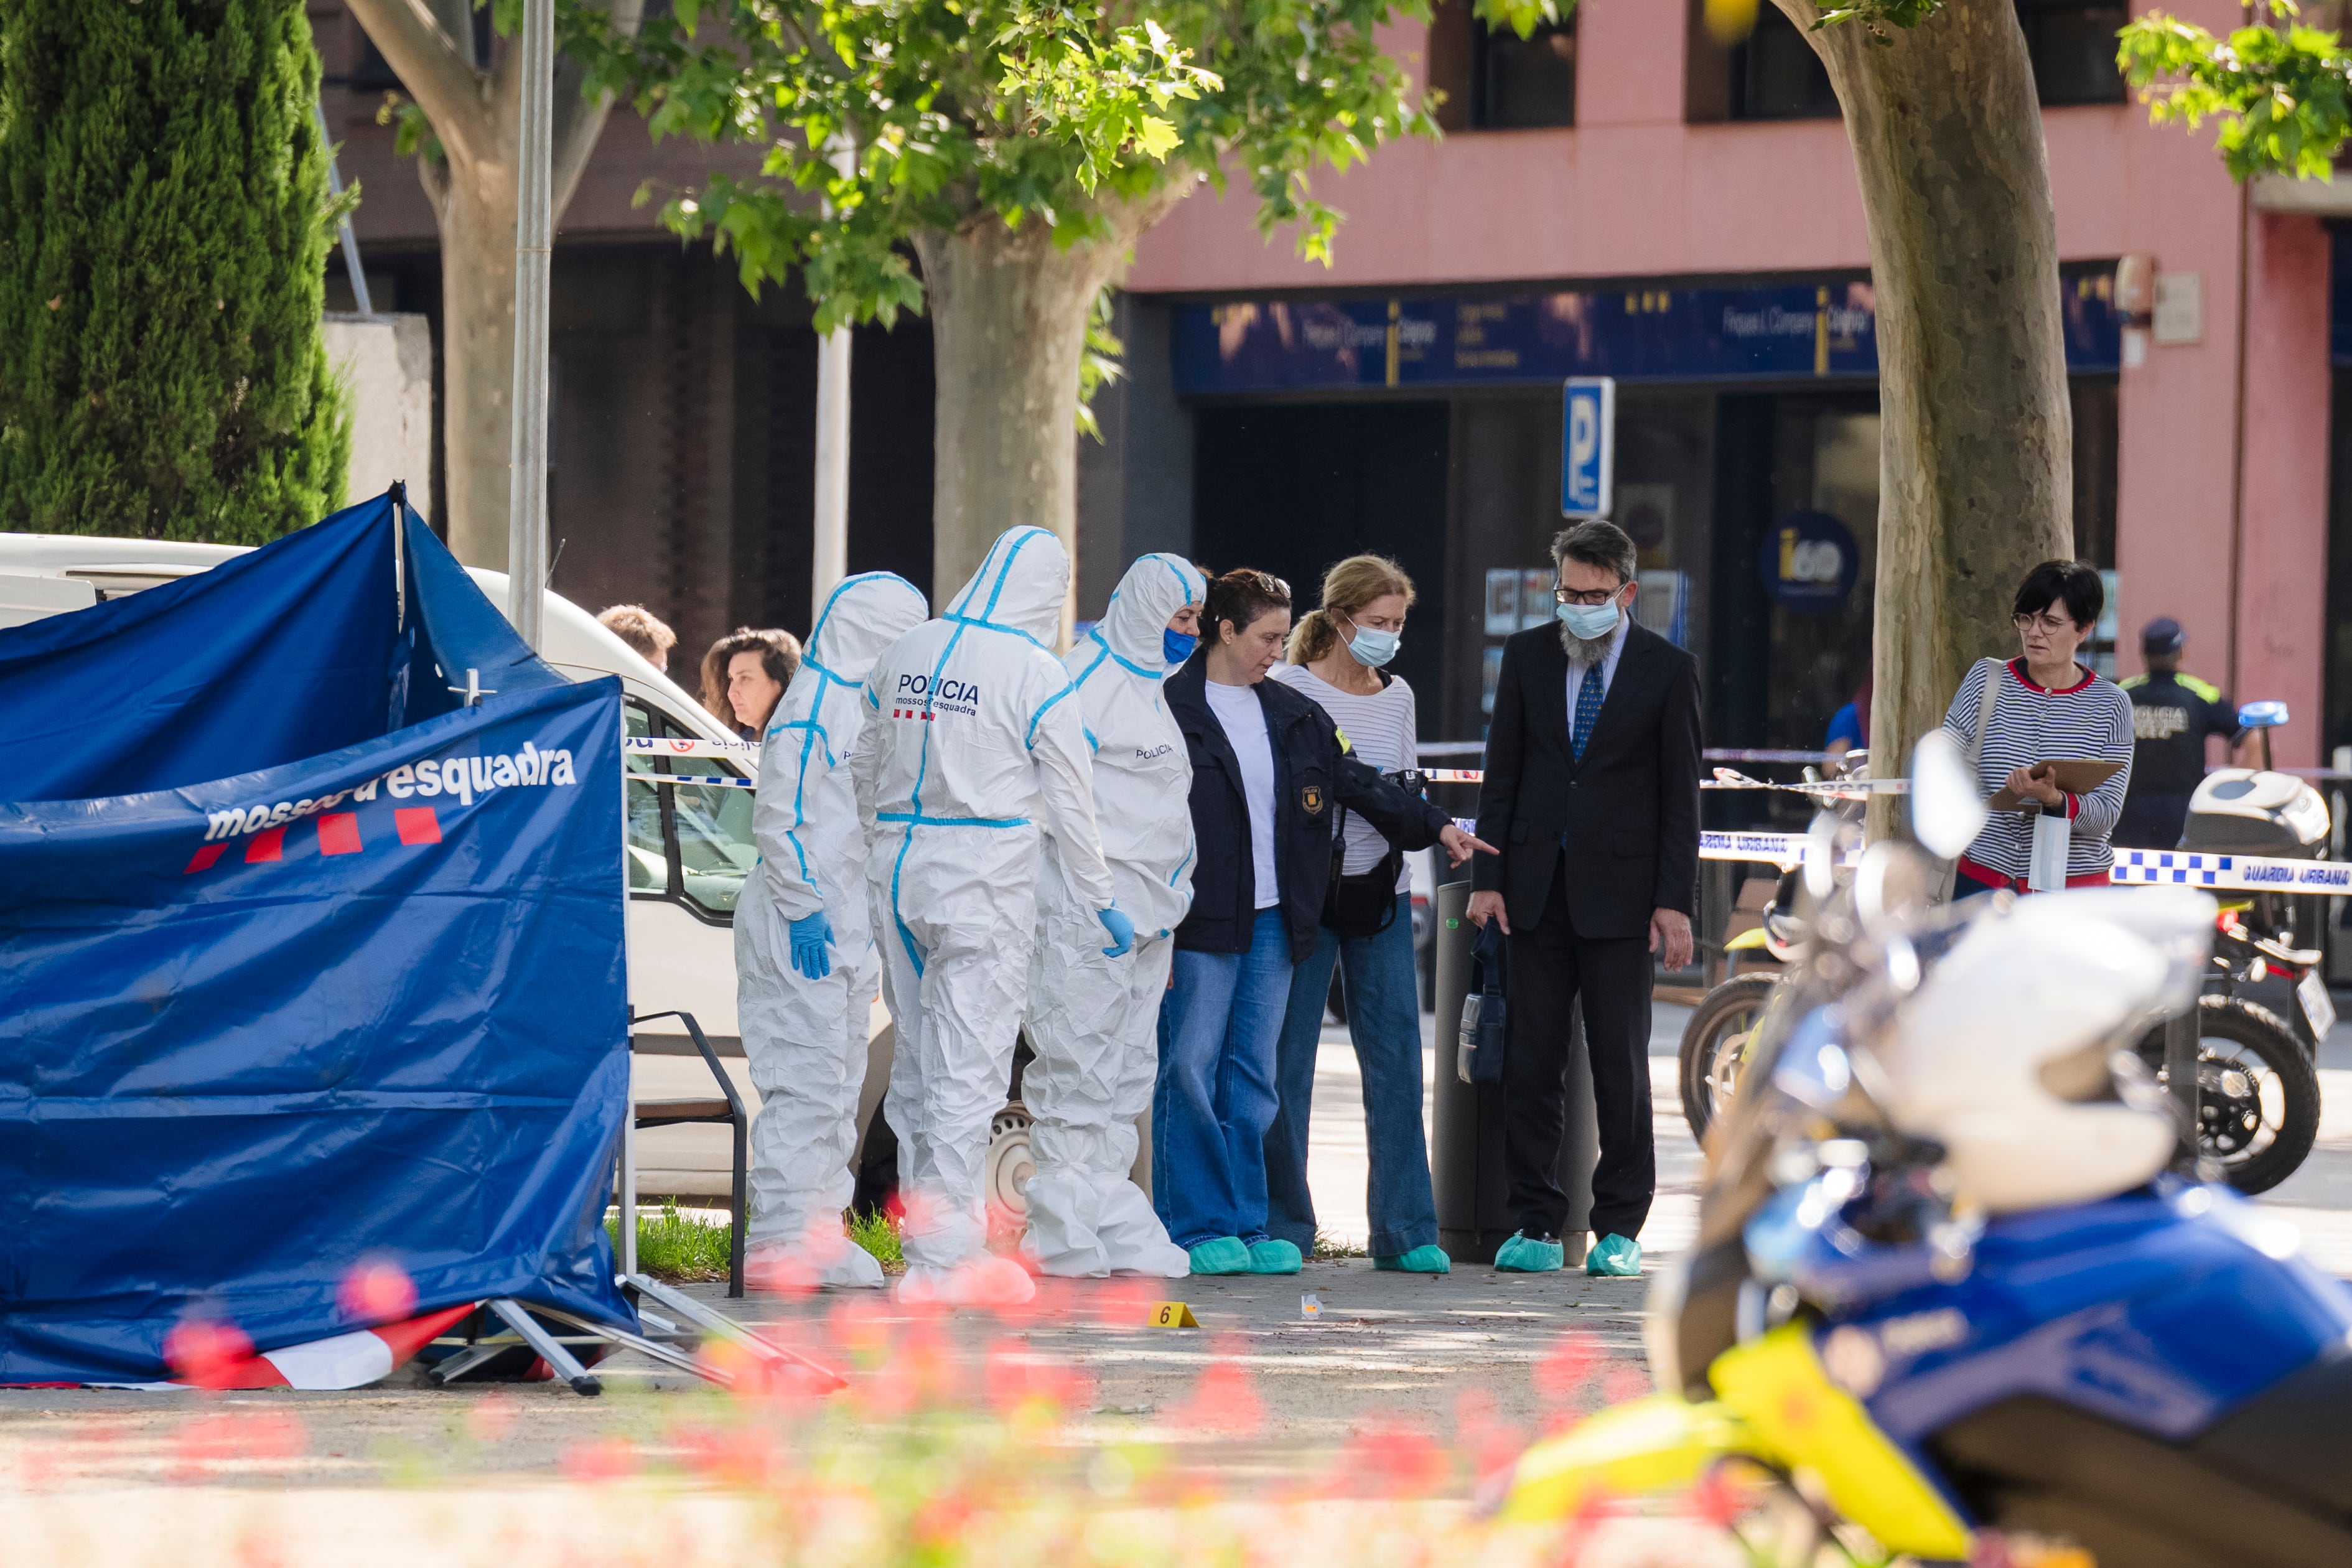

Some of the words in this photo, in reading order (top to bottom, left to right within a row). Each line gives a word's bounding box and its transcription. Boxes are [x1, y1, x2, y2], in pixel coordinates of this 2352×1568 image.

[1136, 744, 1174, 759] POLICIA
[2244, 865, 2294, 882] GUARDIA
[2300, 869, 2350, 885] URBANA
[1159, 1305, 1171, 1323] 6
